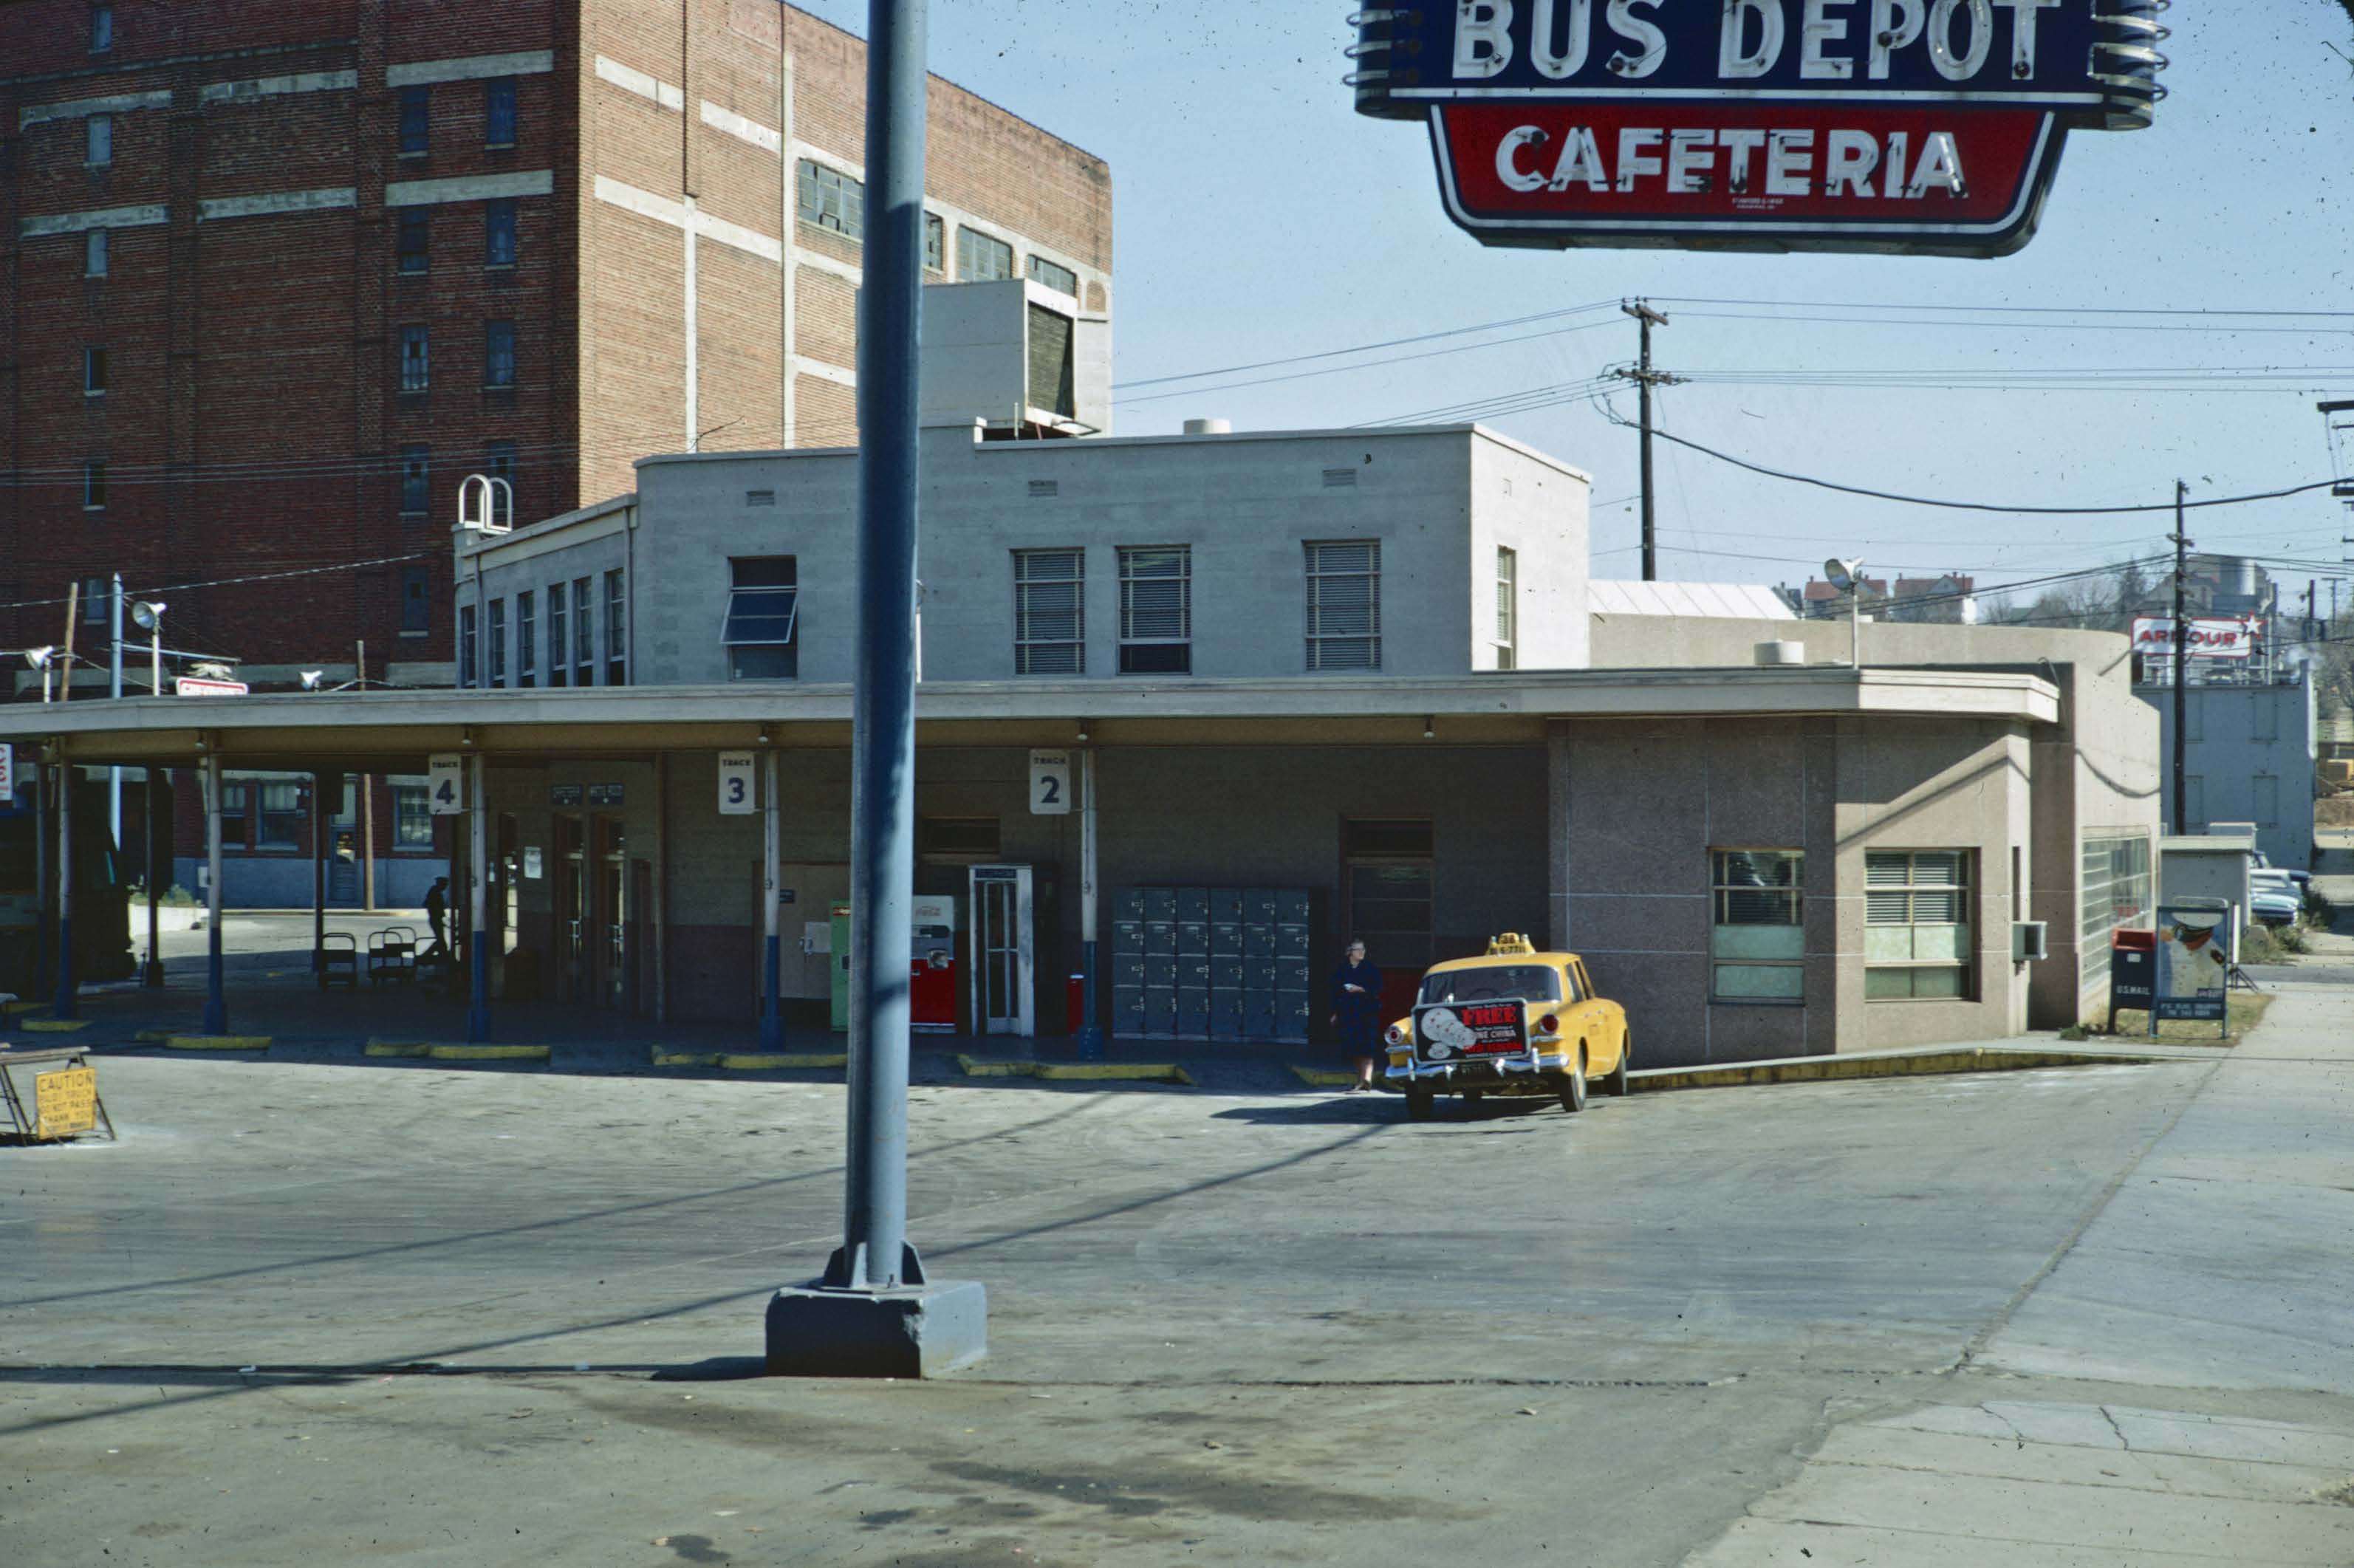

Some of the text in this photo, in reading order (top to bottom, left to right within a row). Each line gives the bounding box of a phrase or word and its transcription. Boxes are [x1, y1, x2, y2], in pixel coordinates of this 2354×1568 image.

[1451, 0, 2061, 81] BUS DEPOT
[1495, 125, 1969, 200] CAFETERIA
[2138, 630, 2237, 646] AROUR
[722, 758, 751, 767] TRACK
[1034, 757, 1067, 765] TRACK
[436, 780, 455, 804] 4
[728, 778, 745, 804] 3
[1041, 776, 1060, 804] 2
[1462, 1007, 1516, 1026] FREE
[40, 1072, 92, 1092] CAUTION
